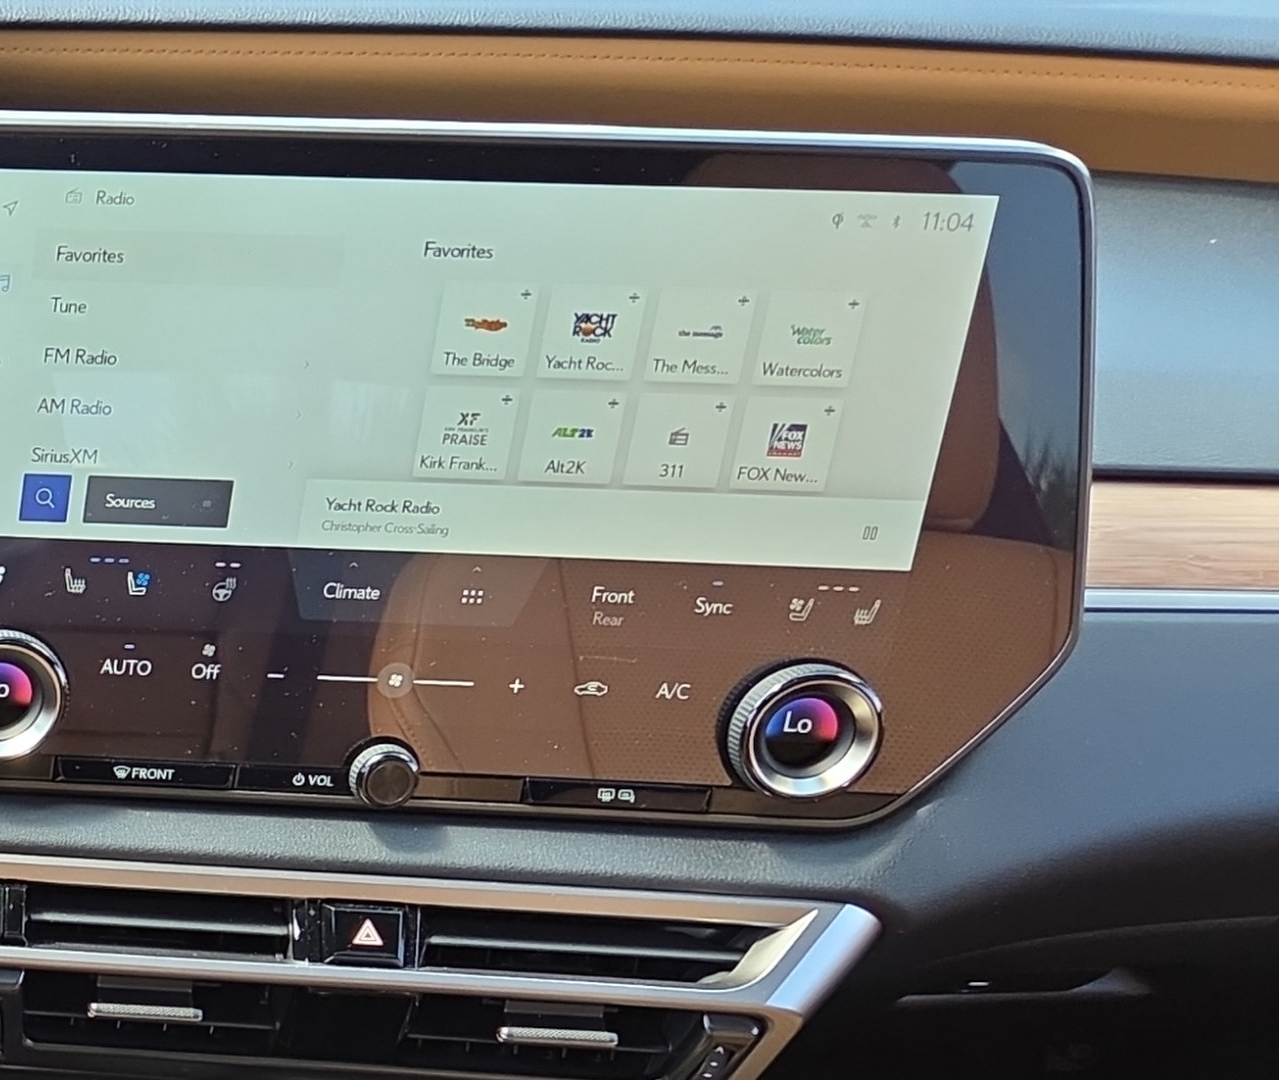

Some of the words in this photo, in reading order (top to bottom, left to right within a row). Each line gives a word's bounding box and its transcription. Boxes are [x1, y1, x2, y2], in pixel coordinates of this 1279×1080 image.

[95, 190, 135, 205] Radio
[922, 211, 975, 232] 11:04
[56, 245, 125, 264] Favorites
[424, 241, 494, 259] Favorites
[51, 296, 87, 313] Tune
[573, 312, 618, 326] YACHT
[43, 348, 70, 364] FM
[75, 349, 117, 366] Radio
[444, 352, 468, 367] The
[472, 353, 515, 371] Bridge
[545, 355, 582, 371] Yacht
[585, 357, 624, 372] Roc...
[653, 358, 678, 373] The
[681, 360, 729, 376] Mess...
[762, 362, 843, 379] Watercolors
[37, 398, 65, 414] AM
[70, 399, 112, 416] Radio
[442, 433, 488, 446] PRAISE
[782, 430, 805, 441] FOX
[773, 440, 803, 451] NEWS
[31, 447, 98, 465] SiriusXM
[419, 455, 445, 470] Kirk
[449, 457, 498, 472] Frank...
[544, 460, 586, 474] Alt2K
[659, 464, 684, 478] 311
[737, 466, 771, 482] FOX
[773, 468, 818, 483] New...
[105, 493, 156, 509] Sources
[326, 497, 362, 512] Yacht
[365, 499, 398, 513] Rock
[402, 500, 441, 514] Radio
[322, 520, 381, 534] Christopher
[323, 582, 381, 601] Climate
[591, 586, 635, 605] Front
[694, 596, 733, 618] Sync
[592, 611, 624, 627] Rear
[100, 658, 152, 676] AUTO
[191, 663, 222, 680] Off
[656, 682, 691, 700] A/C
[783, 711, 812, 735] Lo
[131, 767, 175, 781] FRONT
[308, 773, 334, 787] VOL
